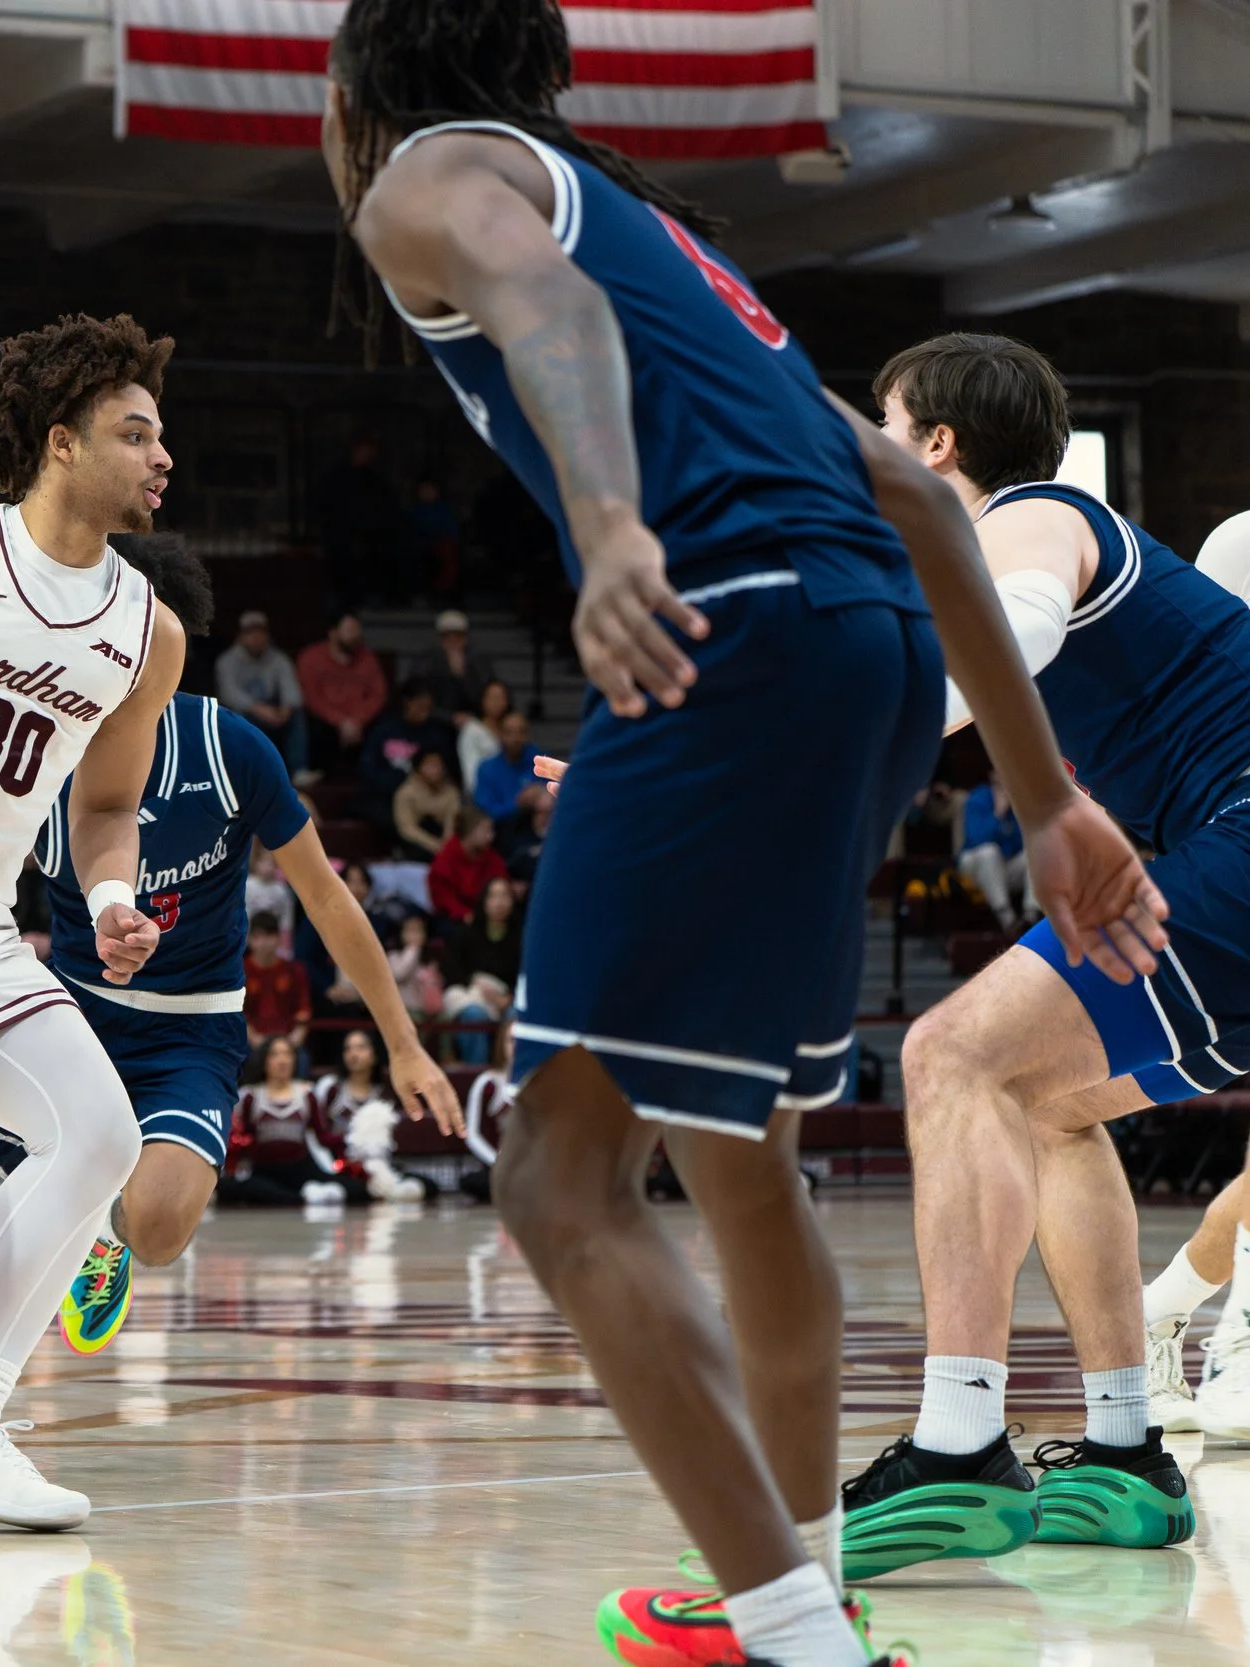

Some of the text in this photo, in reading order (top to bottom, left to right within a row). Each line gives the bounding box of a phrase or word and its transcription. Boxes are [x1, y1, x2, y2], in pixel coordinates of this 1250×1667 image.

[89, 638, 133, 669] A10
[179, 781, 212, 794] A10
[135, 825, 230, 895] hmond
[150, 892, 181, 934] 3
